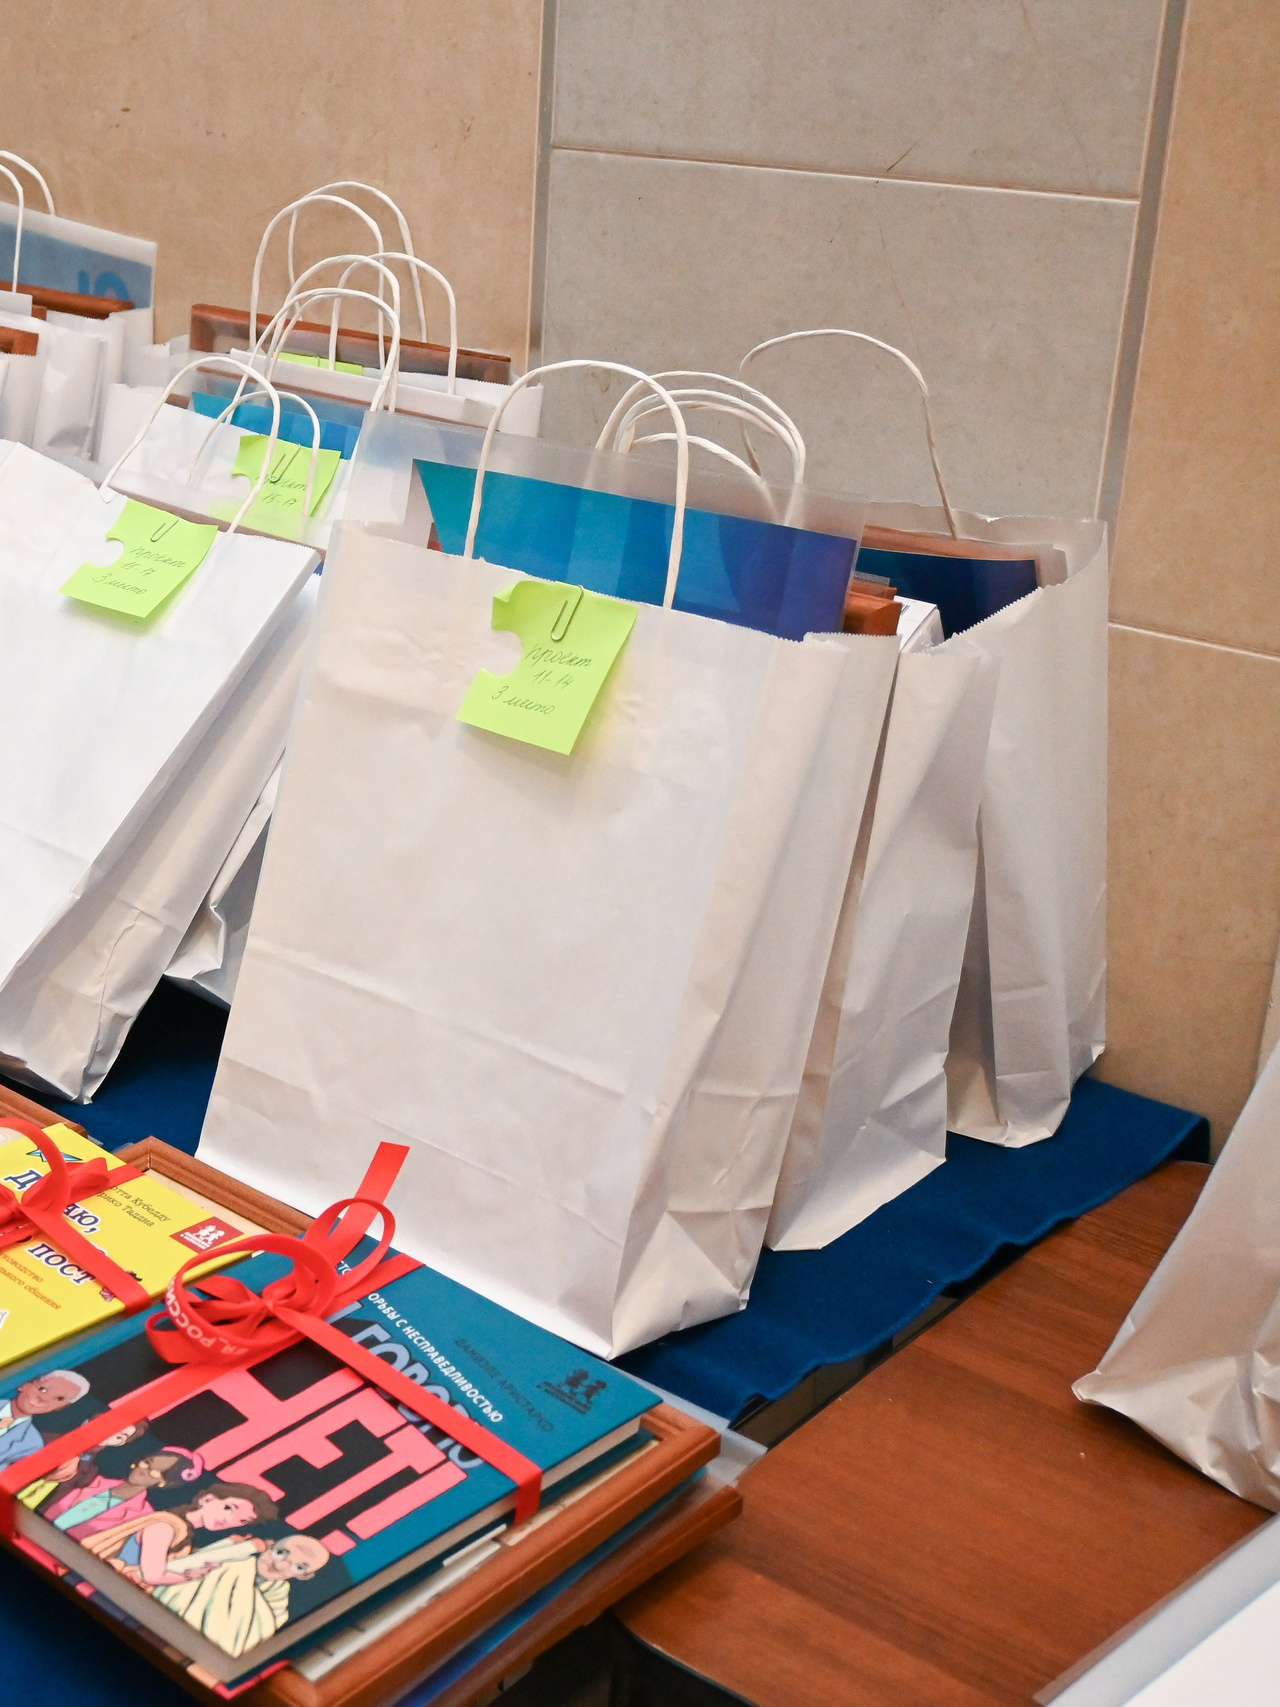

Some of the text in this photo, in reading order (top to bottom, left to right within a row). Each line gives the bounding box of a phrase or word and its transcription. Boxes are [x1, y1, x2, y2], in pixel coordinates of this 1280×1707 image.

[261, 493, 297, 507] 15-17
[129, 546, 186, 568] проект
[92, 573, 113, 583] 3
[525, 643, 592, 671] проект
[533, 669, 574, 688] 11-14
[492, 685, 556, 716] 3 место
[122, 1205, 155, 1227] Таддиа
[131, 1197, 171, 1223] Кубедду
[368, 1292, 401, 1321] ОРЬБЫ
[395, 1317, 408, 1329] С
[402, 1325, 504, 1424] НЕСПРАВЕДЛИВОСТЬЮ
[106, 1342, 468, 1556] НЕТ!
